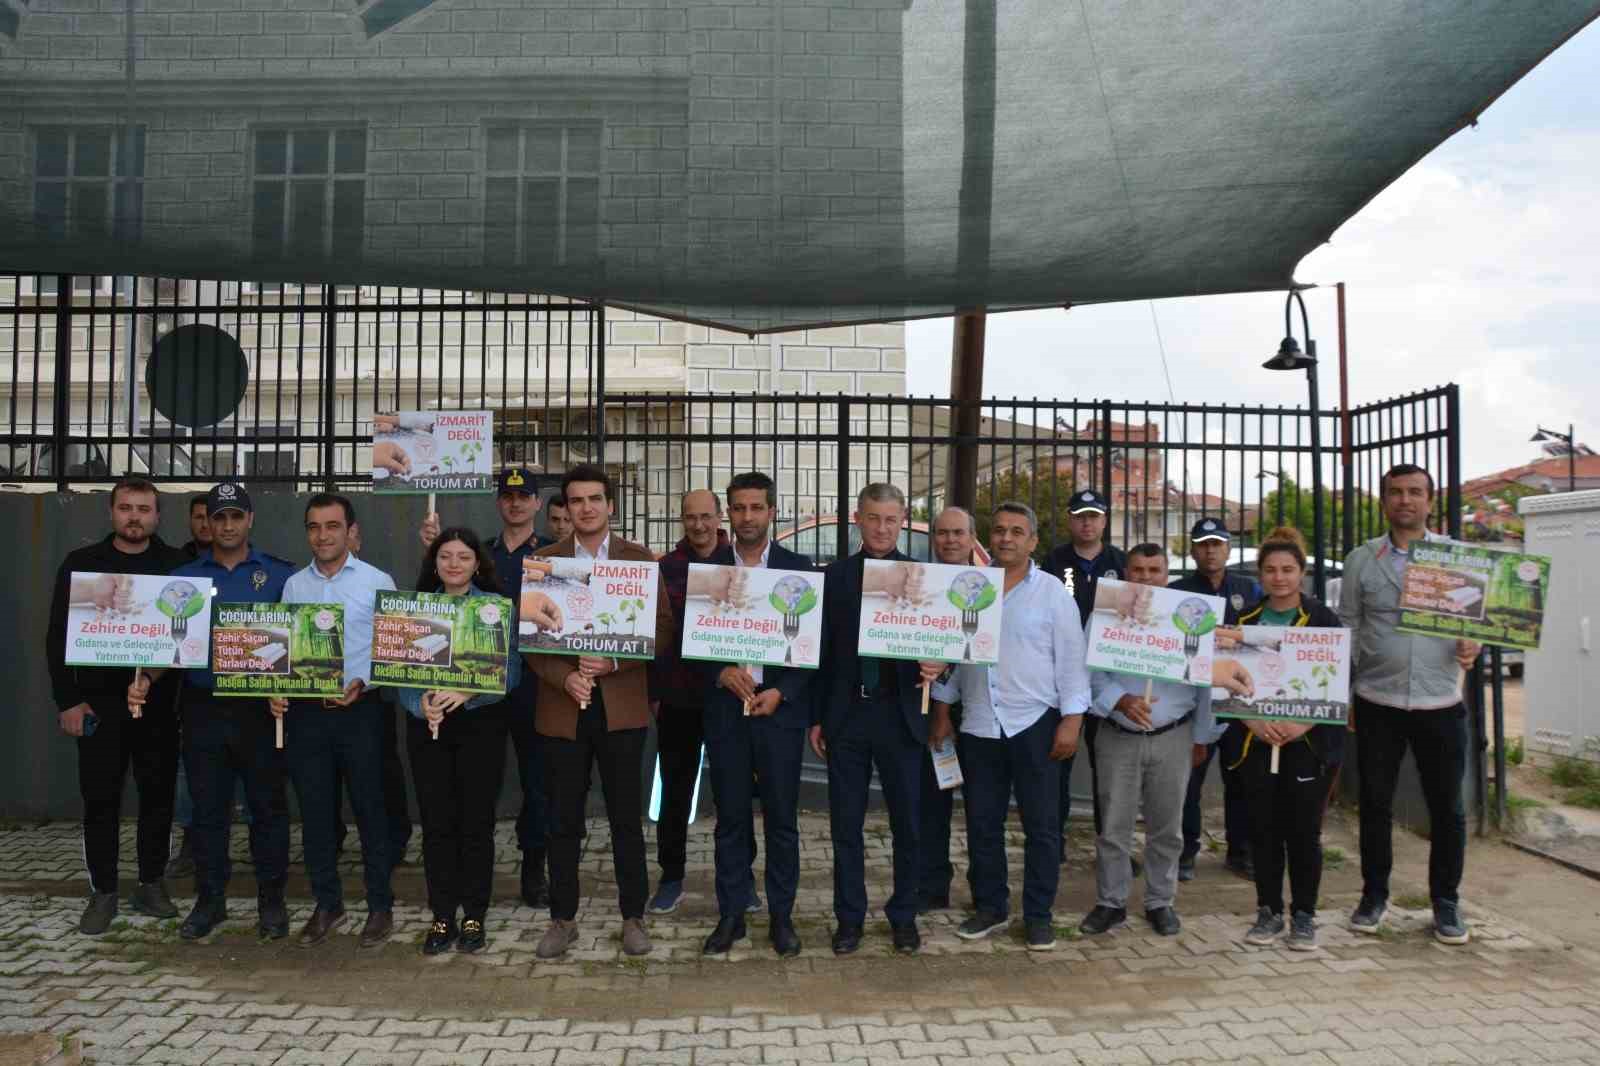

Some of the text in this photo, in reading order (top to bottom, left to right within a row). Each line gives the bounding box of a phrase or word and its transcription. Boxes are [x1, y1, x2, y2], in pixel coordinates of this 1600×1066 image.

[436, 414, 486, 426] İZMARİT
[414, 478, 460, 488] TOHUM
[464, 478, 479, 488] AT
[593, 562, 648, 579] İZMARİT
[606, 581, 648, 598] DEĞİL,
[697, 614, 782, 634] Zehire Değil,
[872, 611, 960, 630] Zehire Değil,
[80, 622, 170, 638] Zehire Değil,
[868, 628, 900, 638] Gıdana
[914, 632, 964, 644] Geleceğine
[1283, 630, 1344, 645] İZMARİT
[110, 640, 122, 648] ve
[566, 638, 617, 652] TOHUM
[622, 640, 638, 652] AT
[692, 631, 784, 648] Gıdana ve Geleceğine
[1102, 626, 1183, 652] Zehire Değil,
[709, 646, 766, 659] Yatırım Yap!
[1296, 648, 1341, 664] DEĞİL,
[1256, 702, 1310, 716] TOHUM
[1313, 706, 1332, 718] AT
